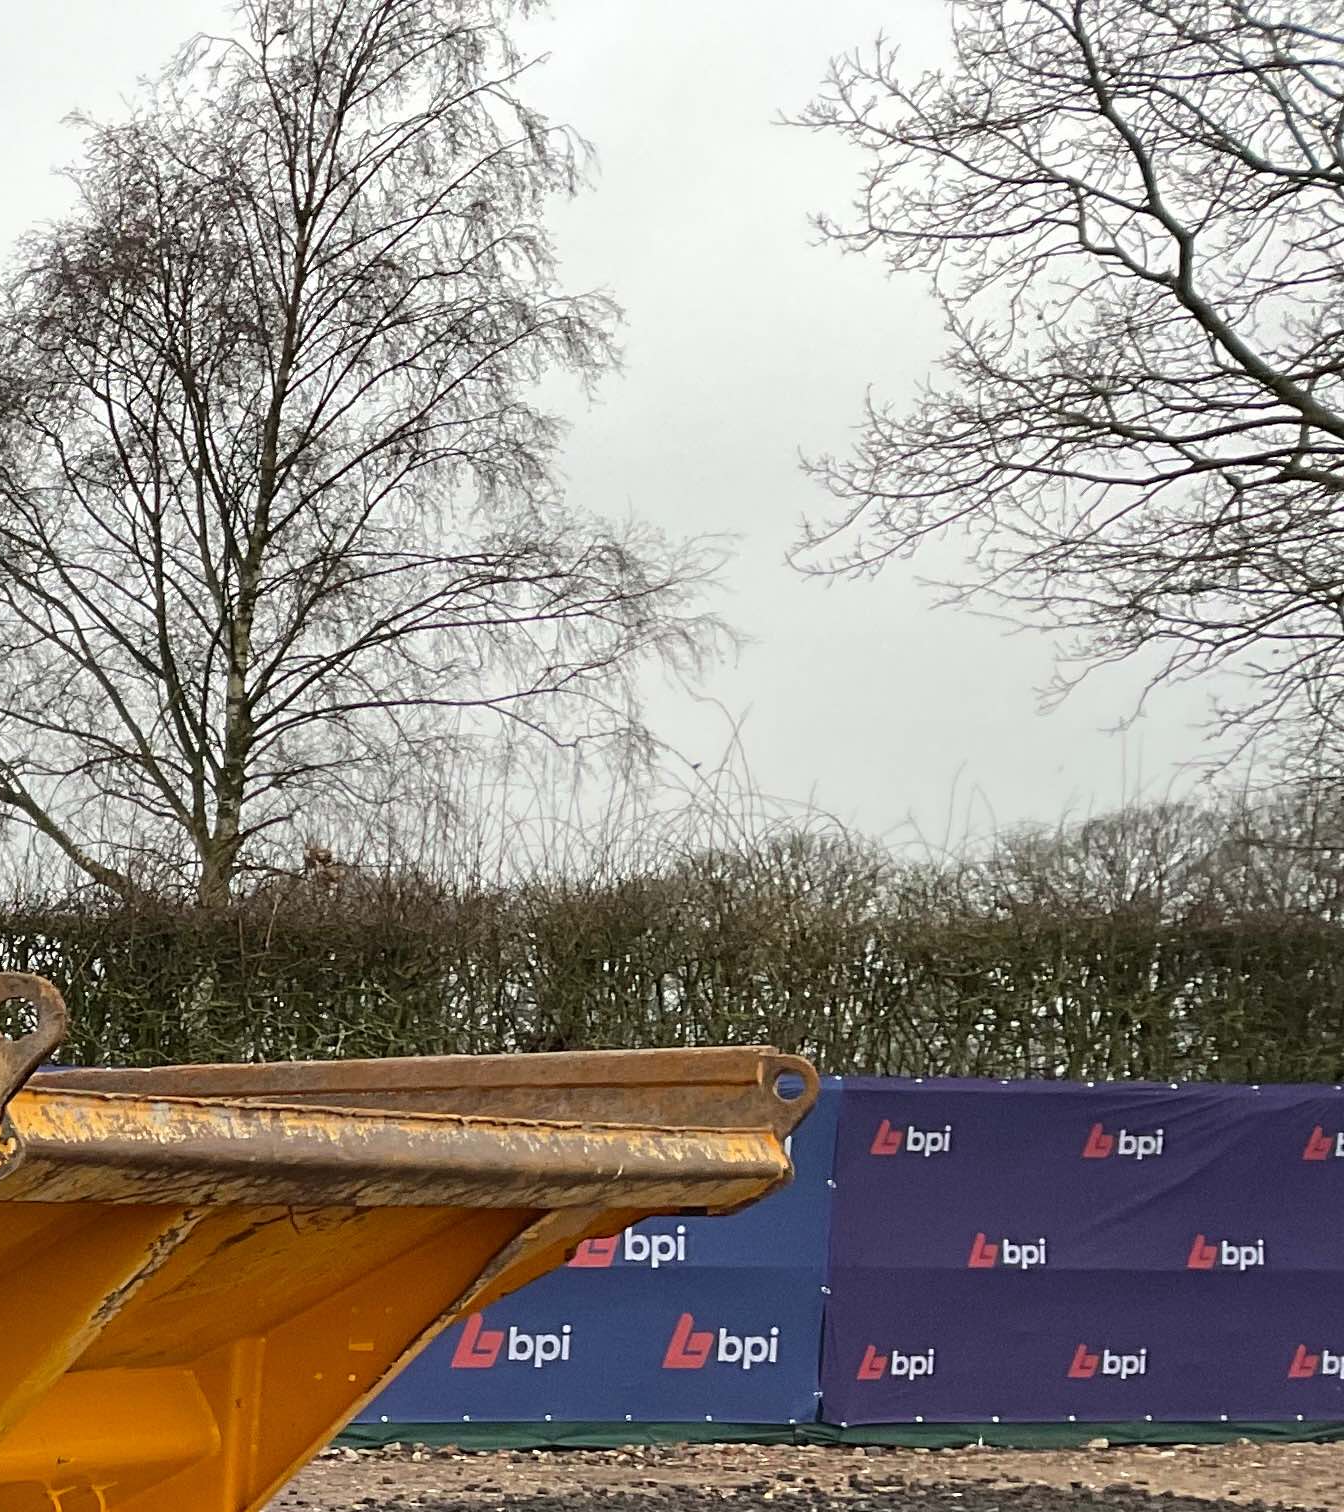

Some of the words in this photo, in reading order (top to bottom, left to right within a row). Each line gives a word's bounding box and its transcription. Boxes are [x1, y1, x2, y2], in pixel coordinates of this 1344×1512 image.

[907, 1125, 951, 1157] bpi
[1119, 1128, 1163, 1160] bpi
[624, 1226, 685, 1268] bpi
[1002, 1237, 1046, 1270] bpi
[1221, 1239, 1265, 1271] bpi
[508, 1324, 571, 1368] bpi
[717, 1326, 779, 1370] bpi
[891, 1348, 935, 1381] bpi
[1102, 1348, 1146, 1380] bpi
